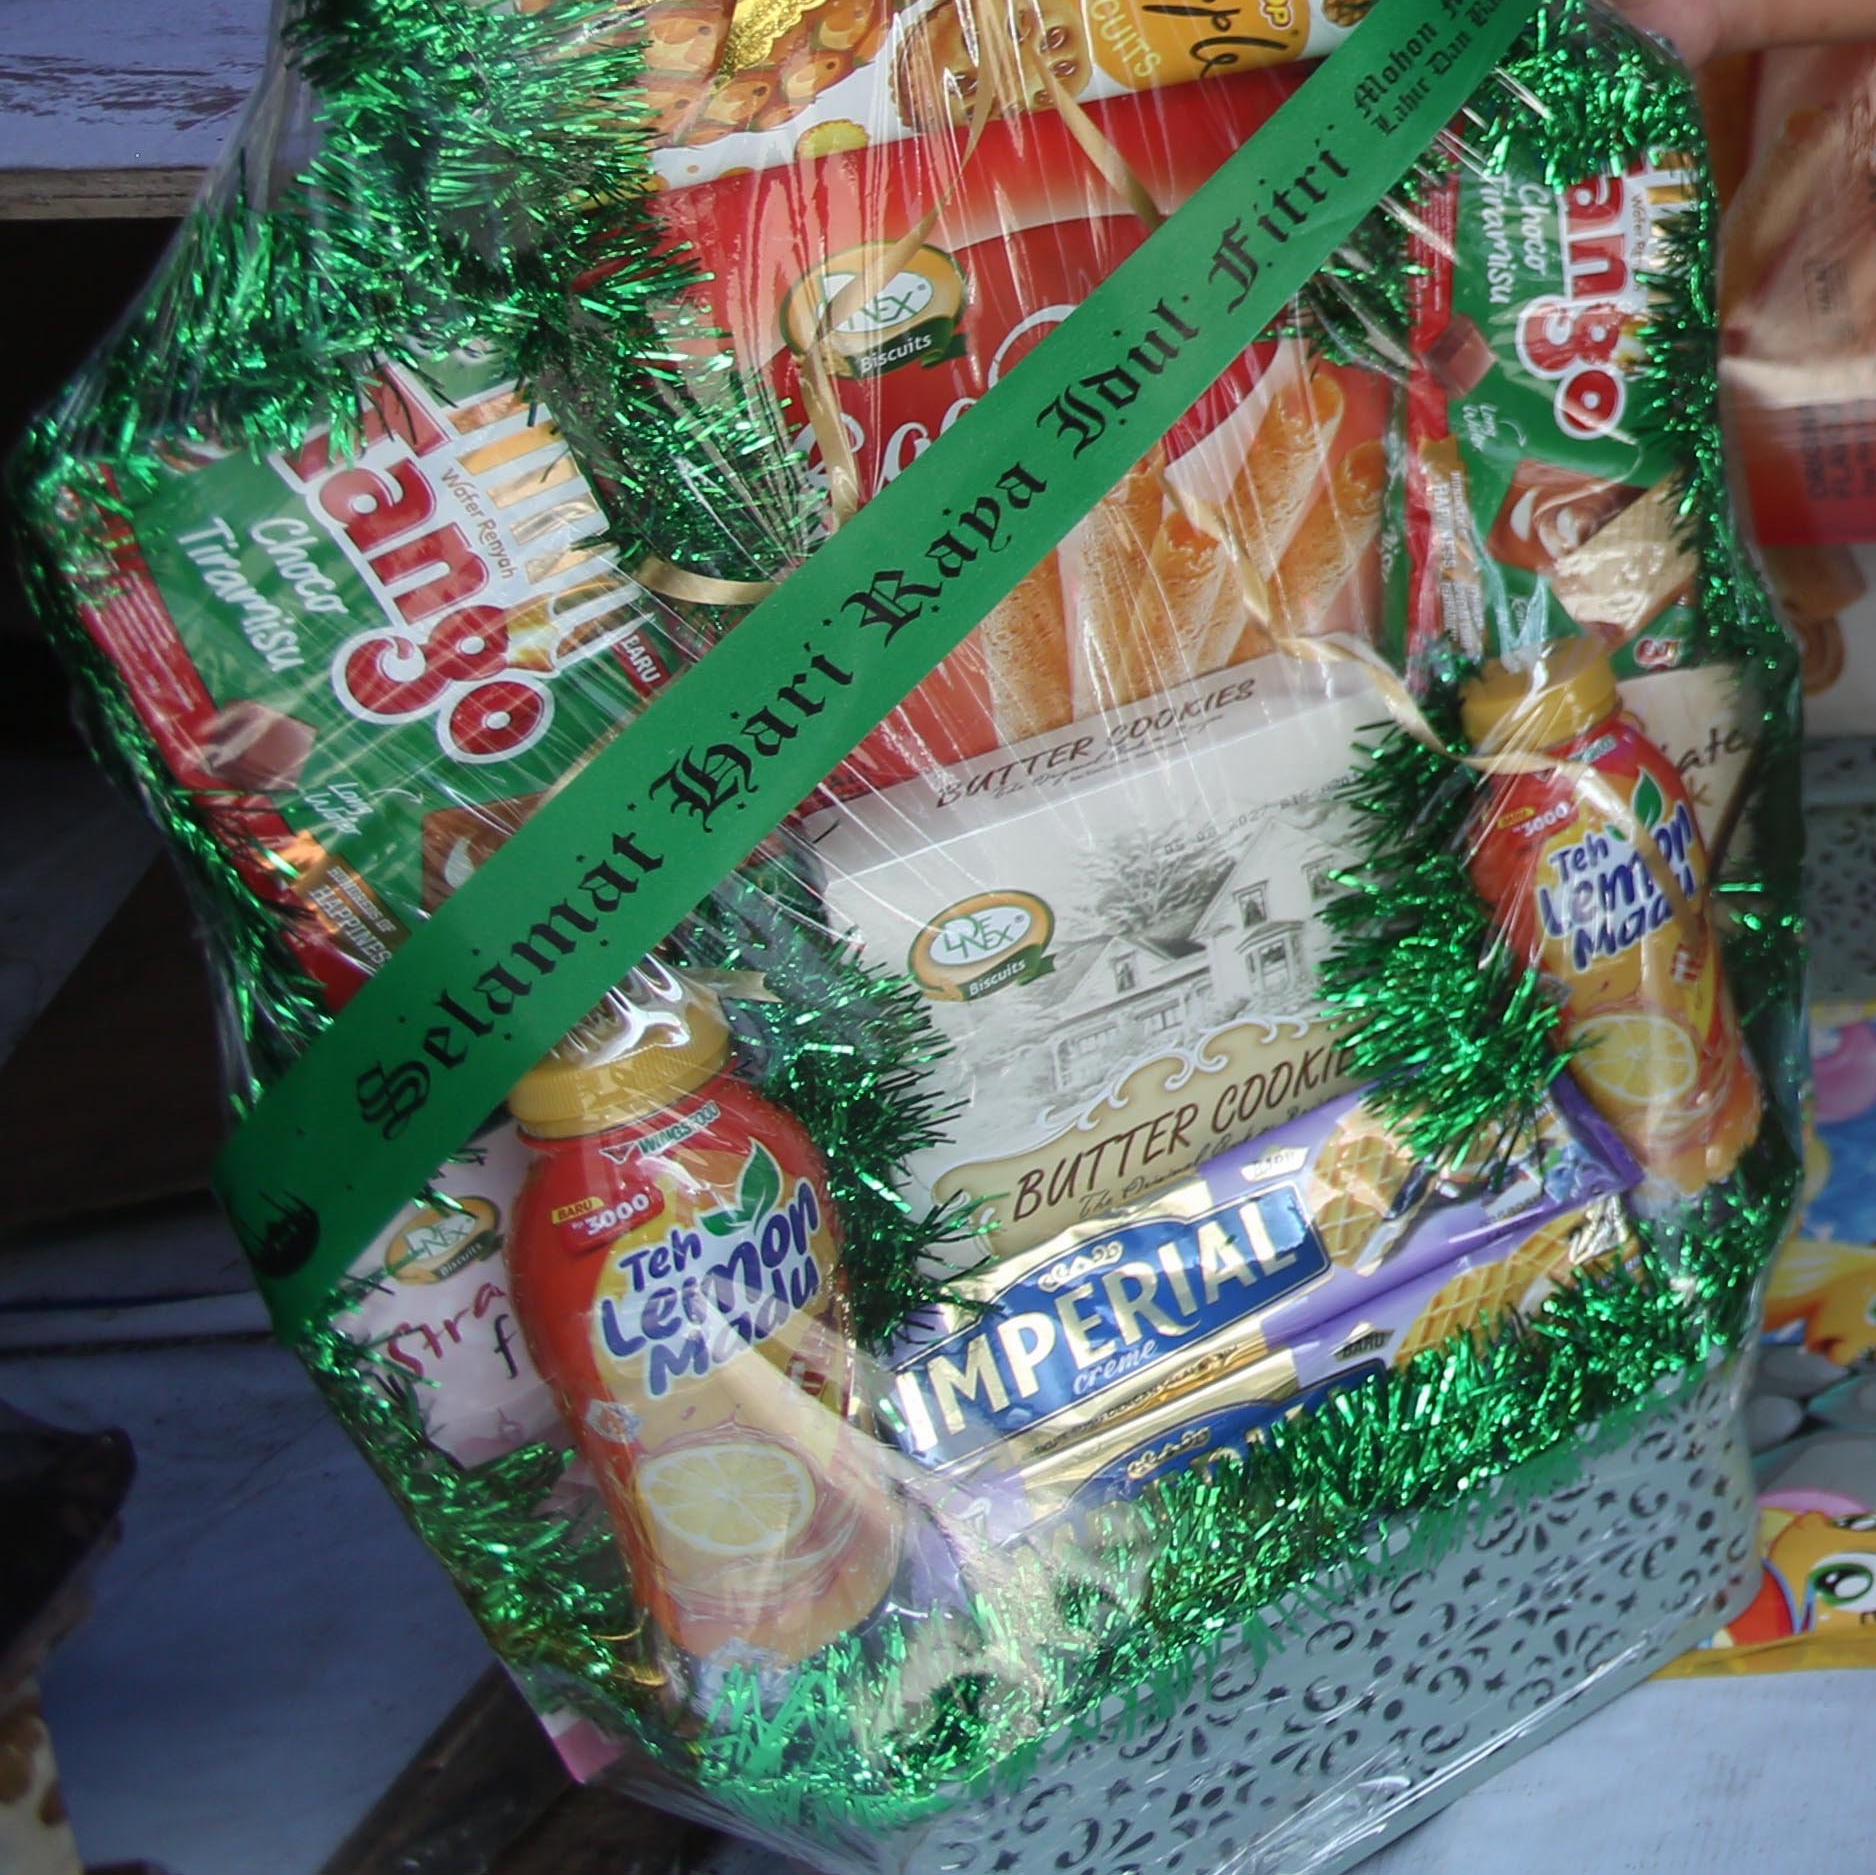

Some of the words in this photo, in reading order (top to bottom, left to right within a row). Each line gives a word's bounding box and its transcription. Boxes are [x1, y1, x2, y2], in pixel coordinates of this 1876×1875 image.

[1353, 21, 1439, 118] Mohon
[1424, 29, 1473, 75] Dan
[1480, 173, 1517, 304] Tiramisu
[1517, 183, 1550, 276] Choco
[1519, 169, 1628, 438] ango
[859, 331, 934, 376] Biscuits
[250, 515, 350, 618] Choco
[440, 467, 485, 521] Wafer
[477, 518, 520, 580] Renyah
[178, 516, 308, 675] Tiramisu
[356, 830, 665, 1140] Selamat
[650, 642, 855, 833] Hari
[841, 460, 1048, 648] Raya
[1036, 296, 1200, 459] Idul
[1206, 138, 1351, 314] Fitri
[620, 634, 662, 684] BARU
[936, 736, 1094, 809] BUTTER
[1106, 677, 1257, 747] COOKIES
[326, 779, 376, 818] Long
[1551, 832, 1610, 882] Teh
[308, 884, 395, 970] HAPPINES
[968, 958, 1027, 997] Biscuits
[638, 1122, 693, 1154] WINGS
[1012, 1102, 1200, 1223] BUTTER
[1210, 1040, 1354, 1135] COOKIE
[556, 1200, 594, 1221] BARU
[585, 1192, 650, 1236] 3000
[601, 1181, 819, 1358] Lemon
[619, 1228, 703, 1293] Teh
[648, 1255, 820, 1397] Madu
[895, 1197, 1301, 1453] IMPERIAL
[1071, 1337, 1159, 1396] creme
